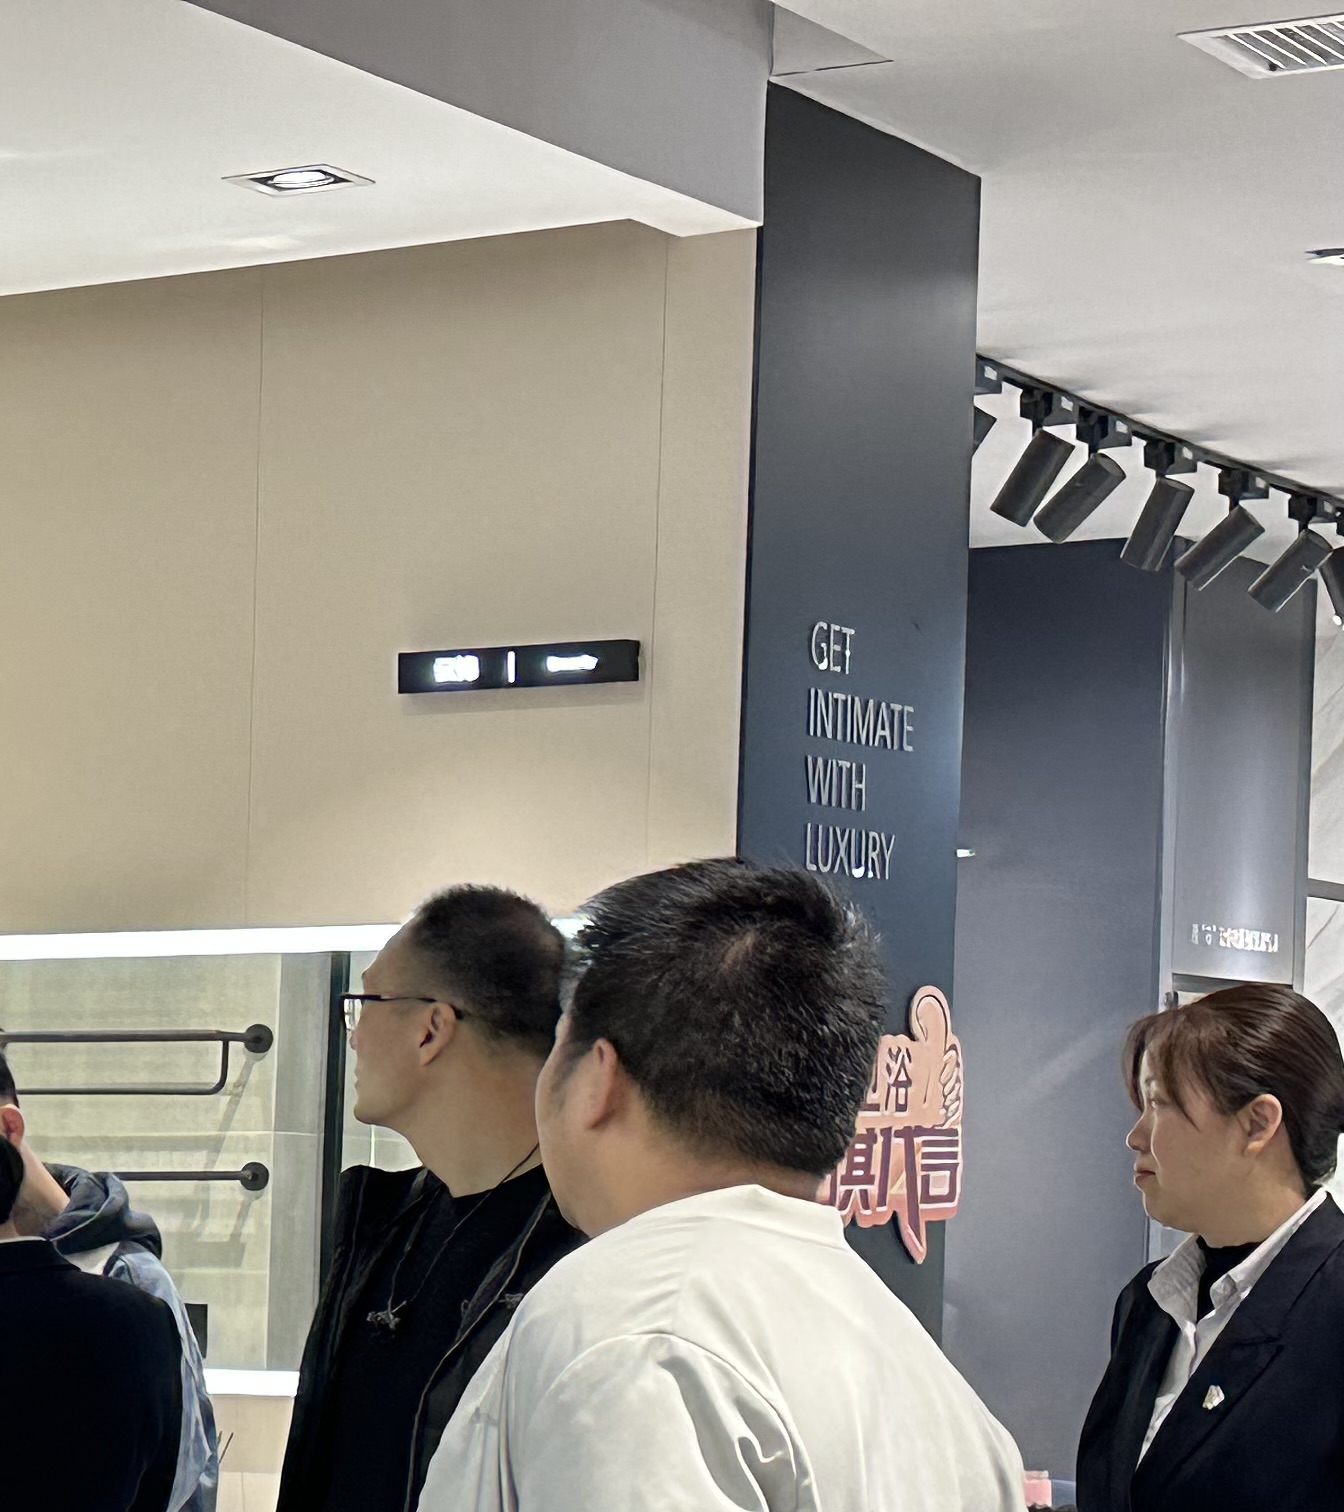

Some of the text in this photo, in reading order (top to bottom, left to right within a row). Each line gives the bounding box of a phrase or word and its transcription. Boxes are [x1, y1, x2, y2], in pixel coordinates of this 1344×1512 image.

[811, 621, 855, 675] GET
[808, 687, 914, 751] INTIMATE
[806, 755, 866, 811] WITH
[805, 823, 895, 880] LUXURY
